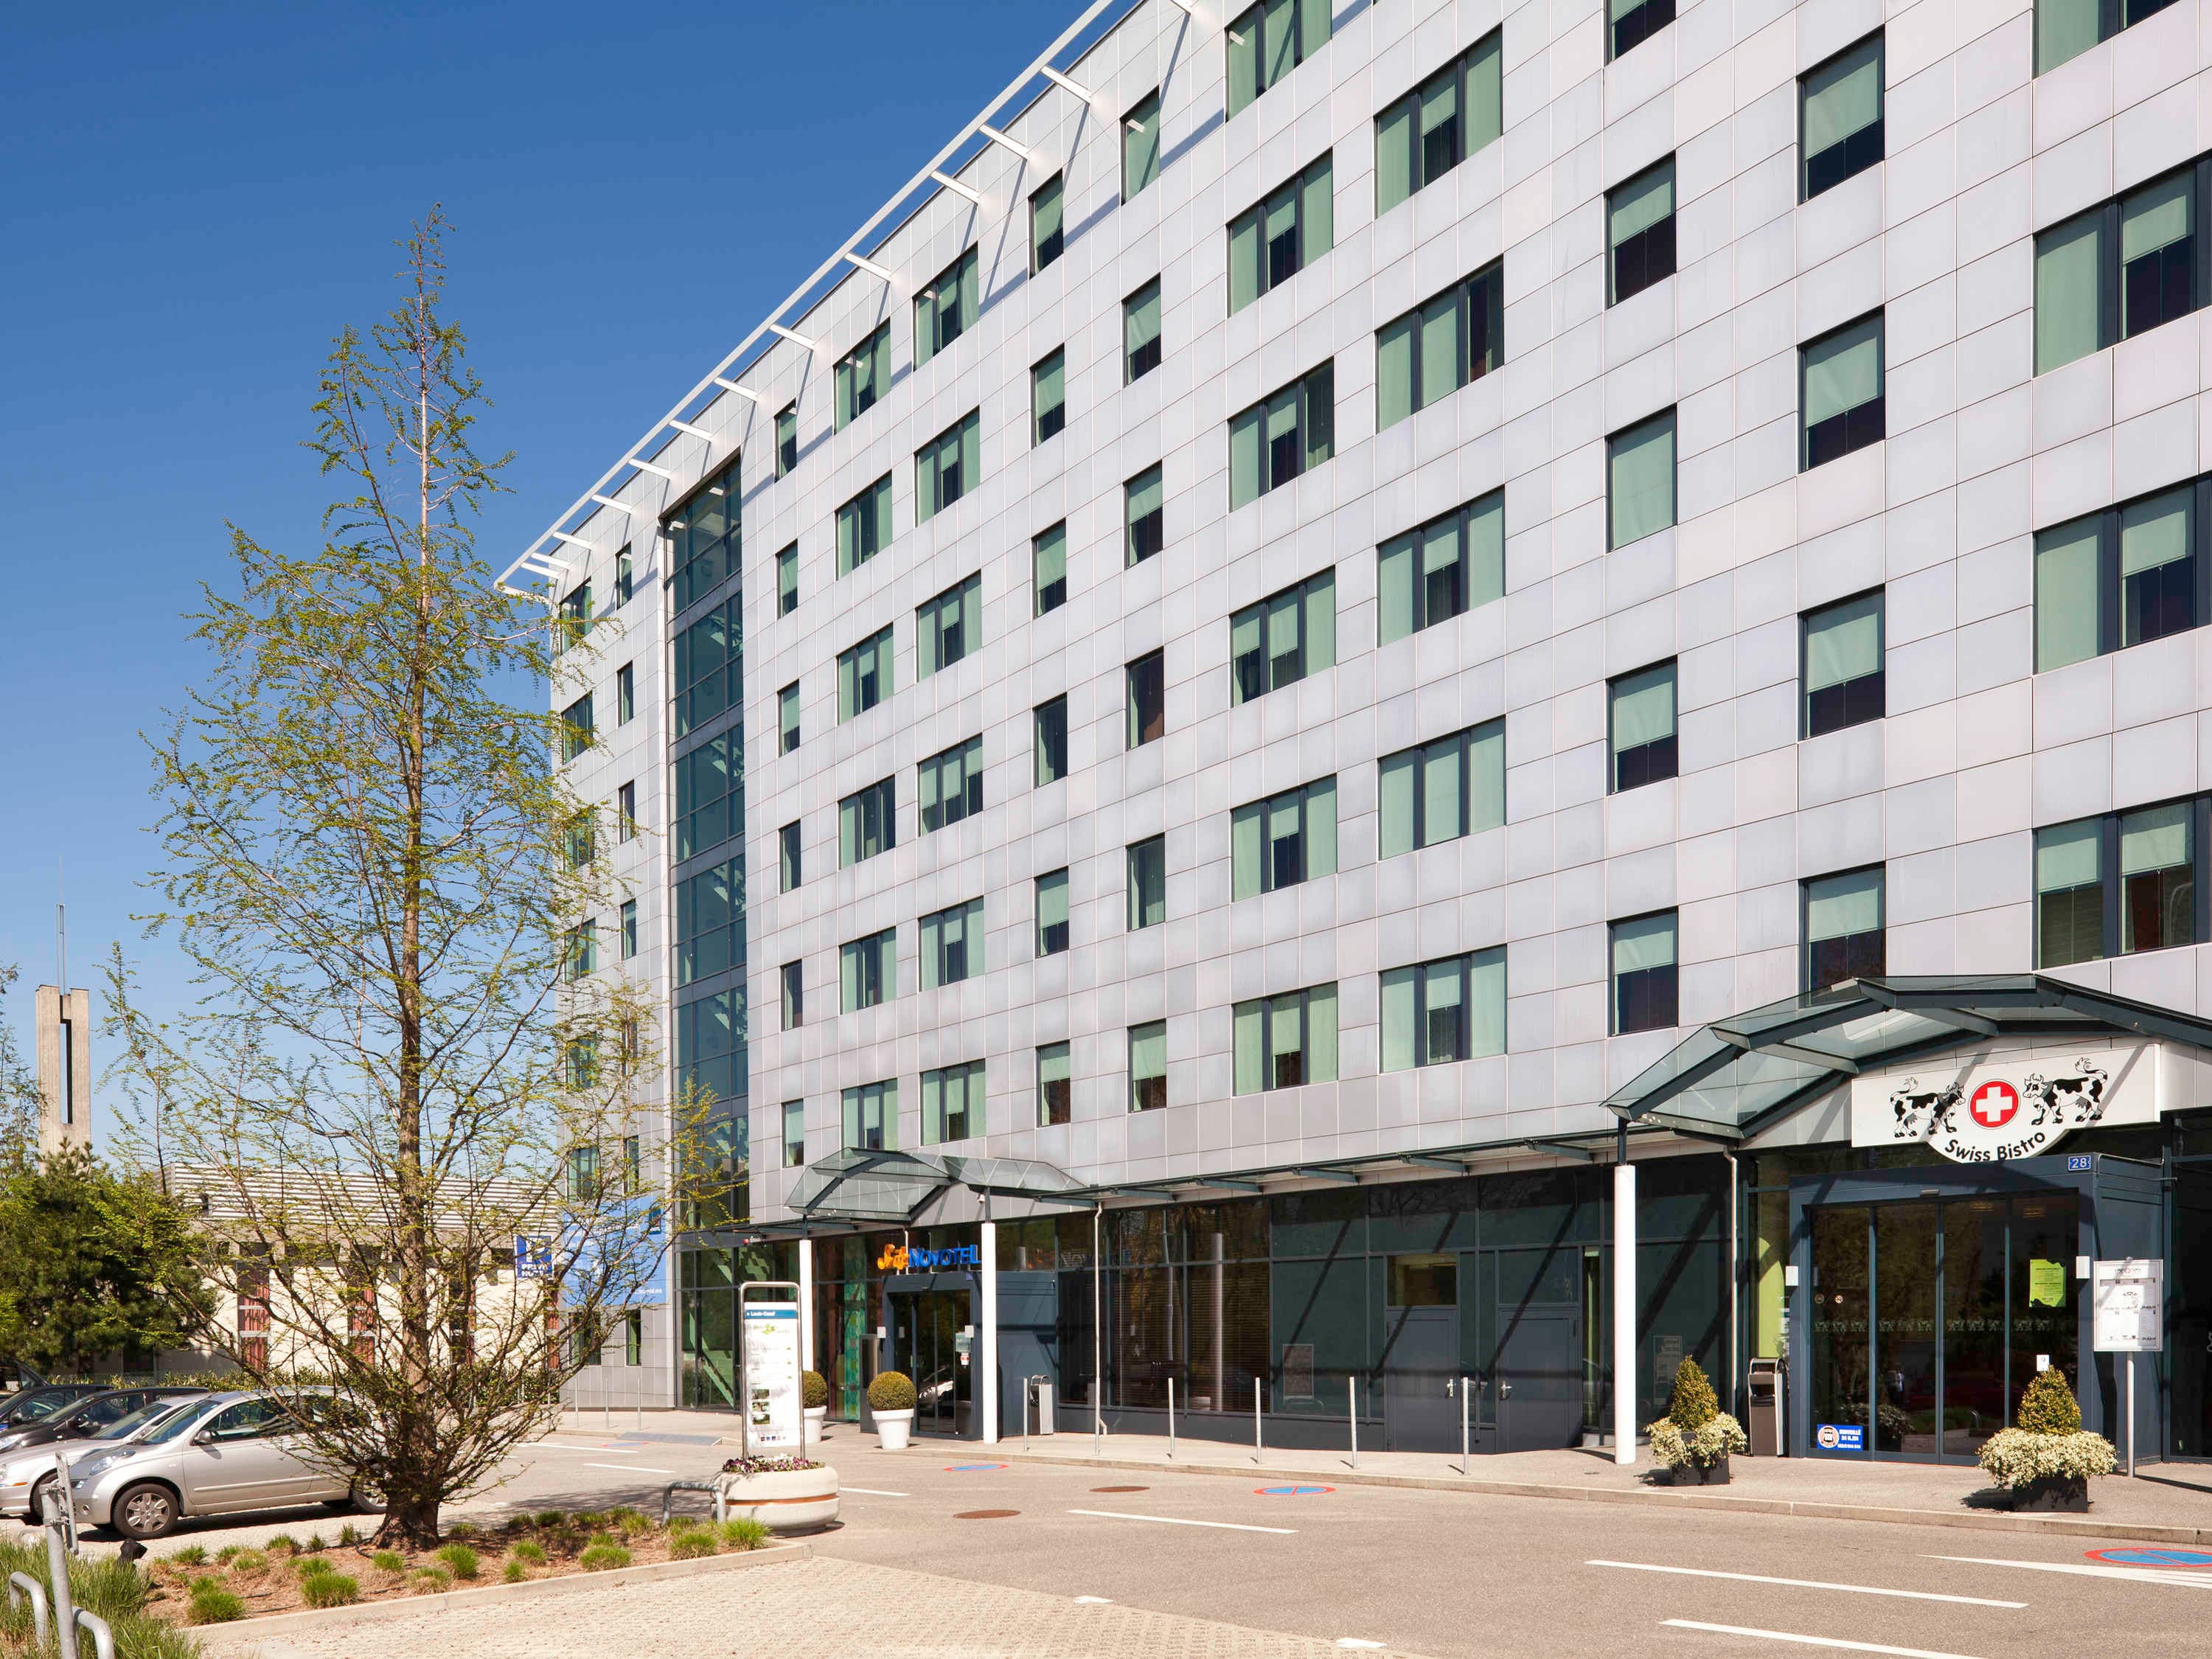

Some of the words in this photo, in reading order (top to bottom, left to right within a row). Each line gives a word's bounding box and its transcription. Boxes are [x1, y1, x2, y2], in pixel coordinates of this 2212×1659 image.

[1945, 1138, 1991, 1162] Swiss
[1997, 1132, 2045, 1161] Bistro
[2071, 1157, 2087, 1169] 28
